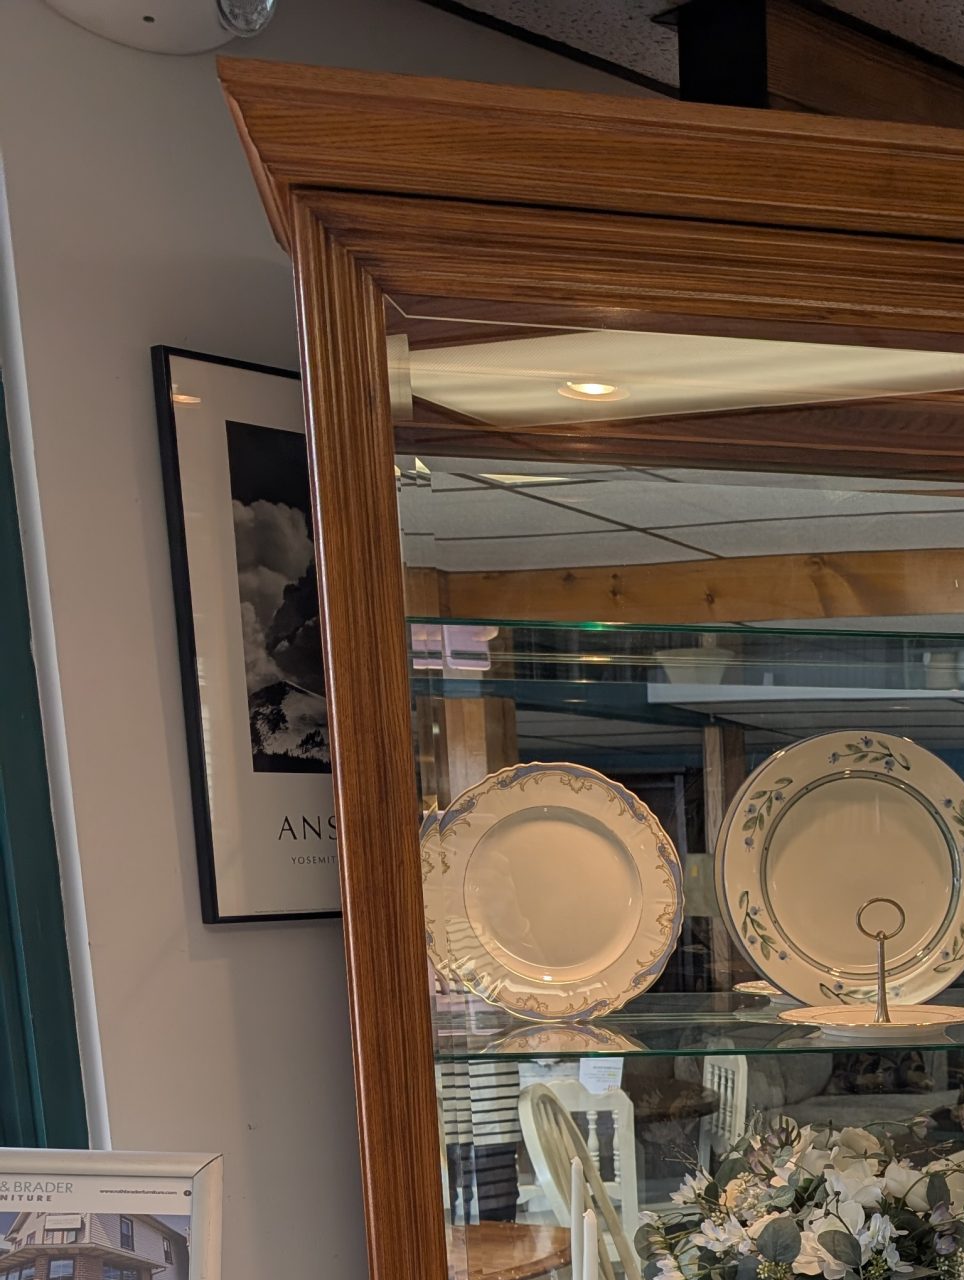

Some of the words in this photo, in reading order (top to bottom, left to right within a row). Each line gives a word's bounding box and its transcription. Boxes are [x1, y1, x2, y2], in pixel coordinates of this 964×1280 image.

[279, 816, 337, 840] ANS
[291, 856, 336, 864] YOSEMIT
[0, 1181, 9, 1192] &
[14, 1181, 73, 1193] BRADER
[0, 1194, 52, 1202] NITURE
